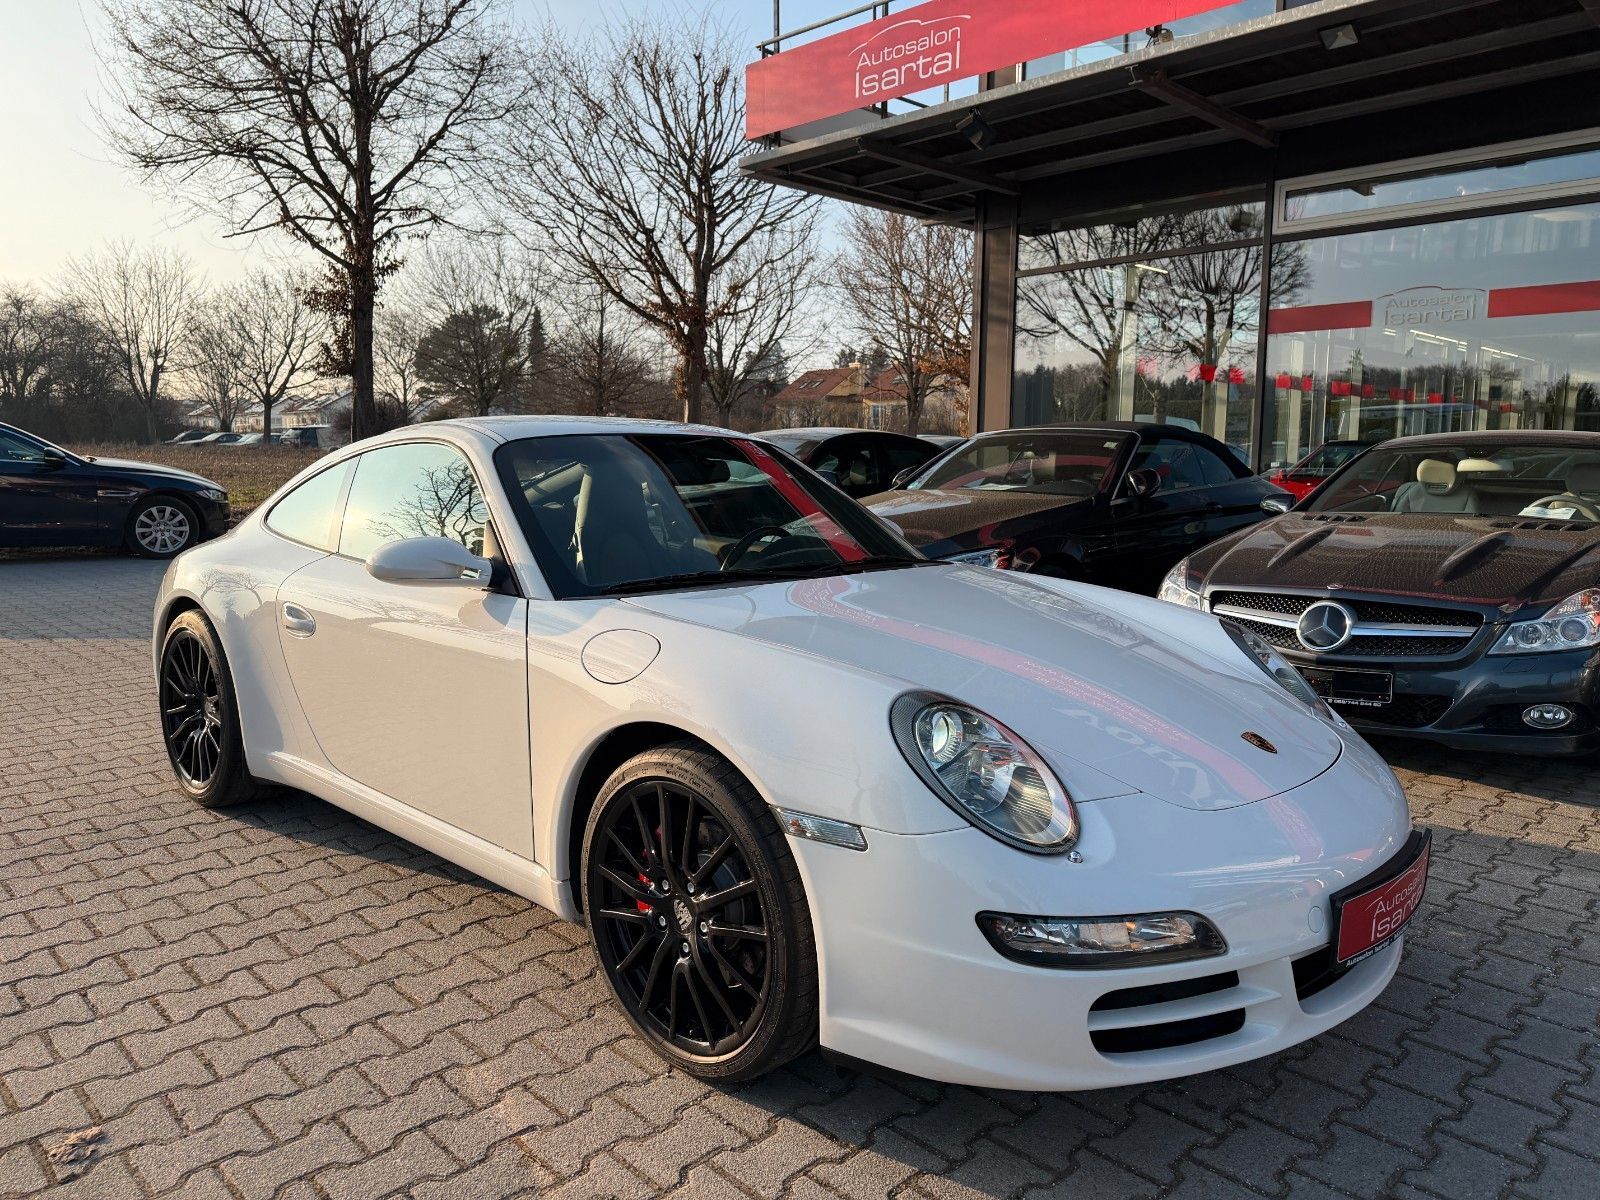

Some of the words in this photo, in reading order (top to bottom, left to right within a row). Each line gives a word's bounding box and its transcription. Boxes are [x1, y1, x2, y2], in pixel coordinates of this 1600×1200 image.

[855, 41, 961, 98] Isartal
[856, 26, 961, 71] Autosalon
[1384, 303, 1477, 326] Isartal
[1385, 292, 1477, 309] Autosalon
[1370, 884, 1422, 942] Isarta
[1374, 867, 1424, 918] Autosa
